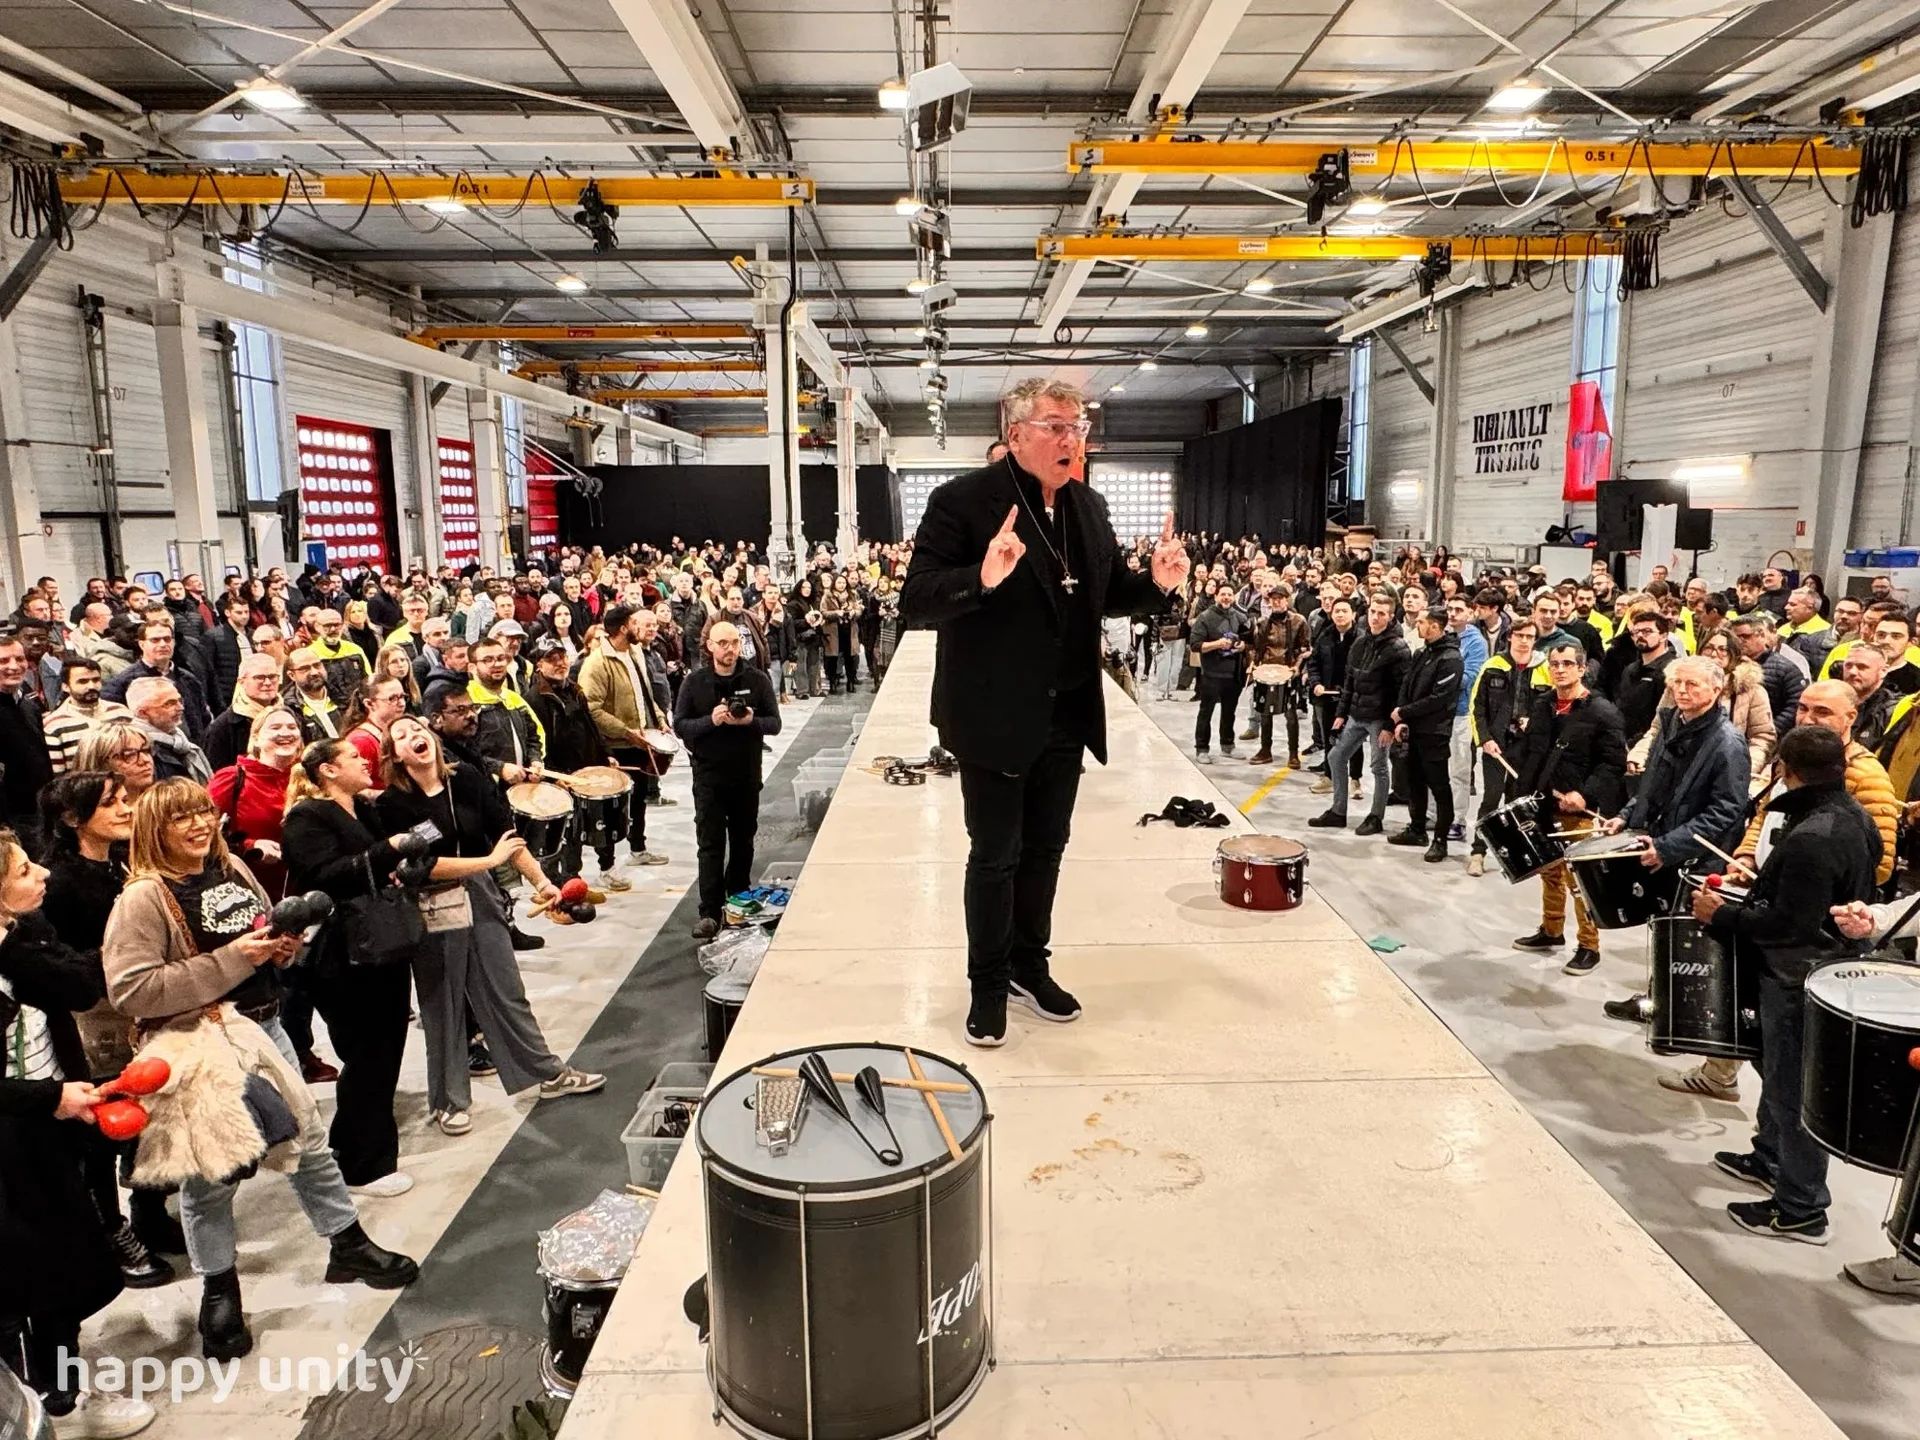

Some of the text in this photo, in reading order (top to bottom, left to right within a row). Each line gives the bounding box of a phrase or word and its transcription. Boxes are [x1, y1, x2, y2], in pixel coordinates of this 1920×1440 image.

[1585, 150, 1606, 161] 0.5
[113, 386, 127, 401] 07
[1722, 383, 1736, 398] 07
[1669, 961, 1715, 976] GOPE
